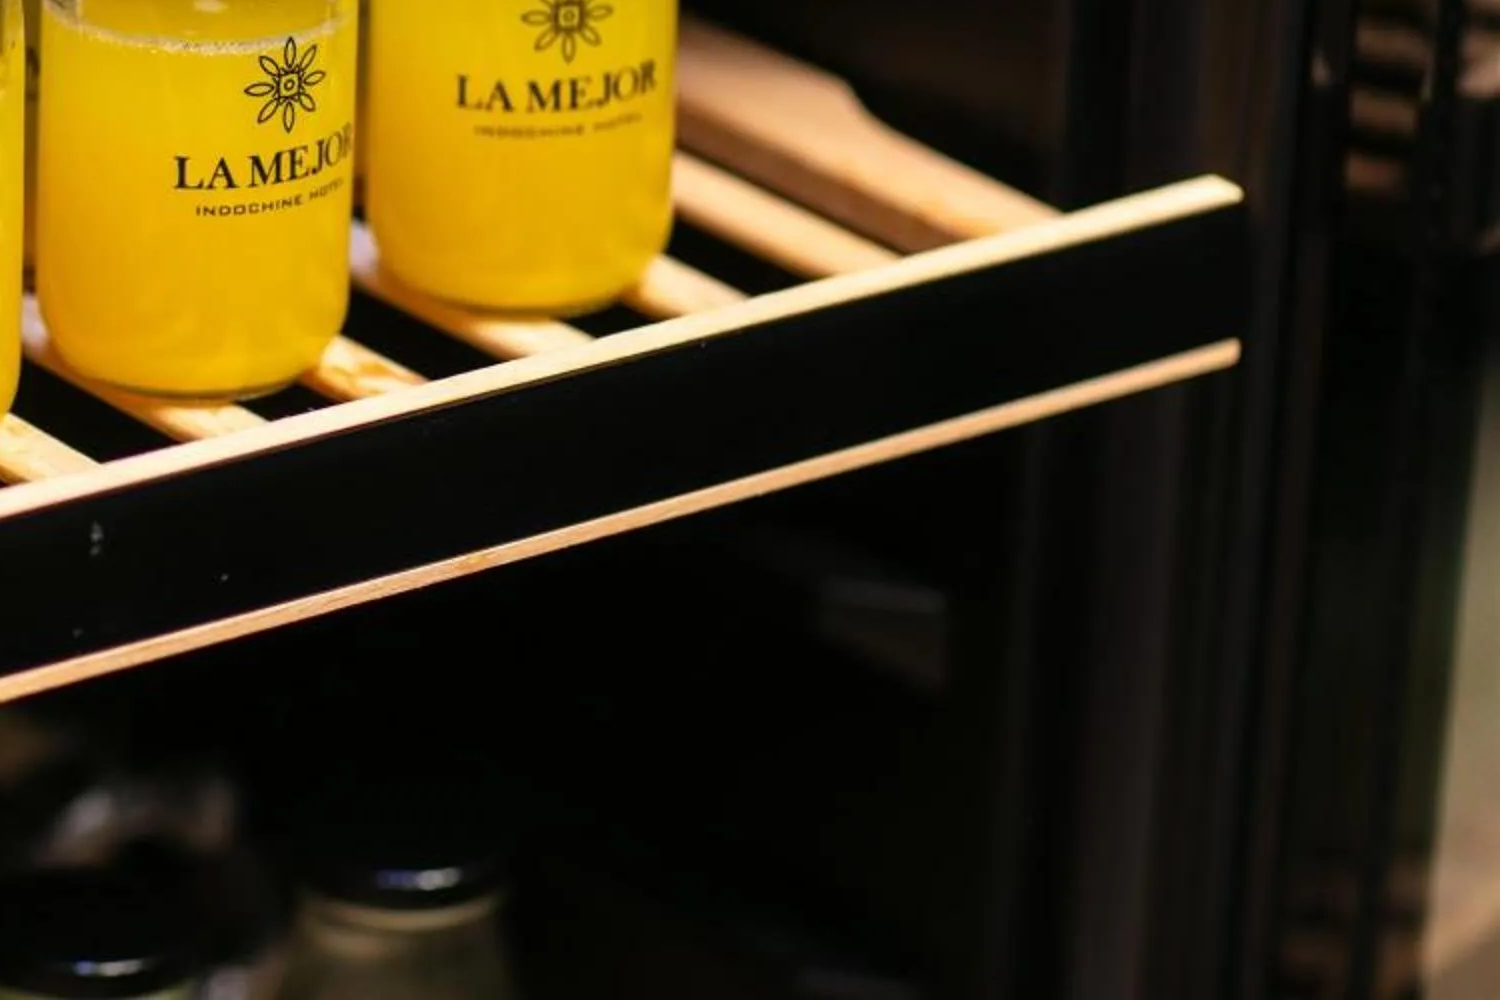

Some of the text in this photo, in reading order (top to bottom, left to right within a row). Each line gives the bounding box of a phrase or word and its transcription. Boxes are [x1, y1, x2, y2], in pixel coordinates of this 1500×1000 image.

[456, 58, 656, 113] LA MEJOR
[174, 155, 239, 190] LA
[196, 194, 303, 217] INDOCHINE
